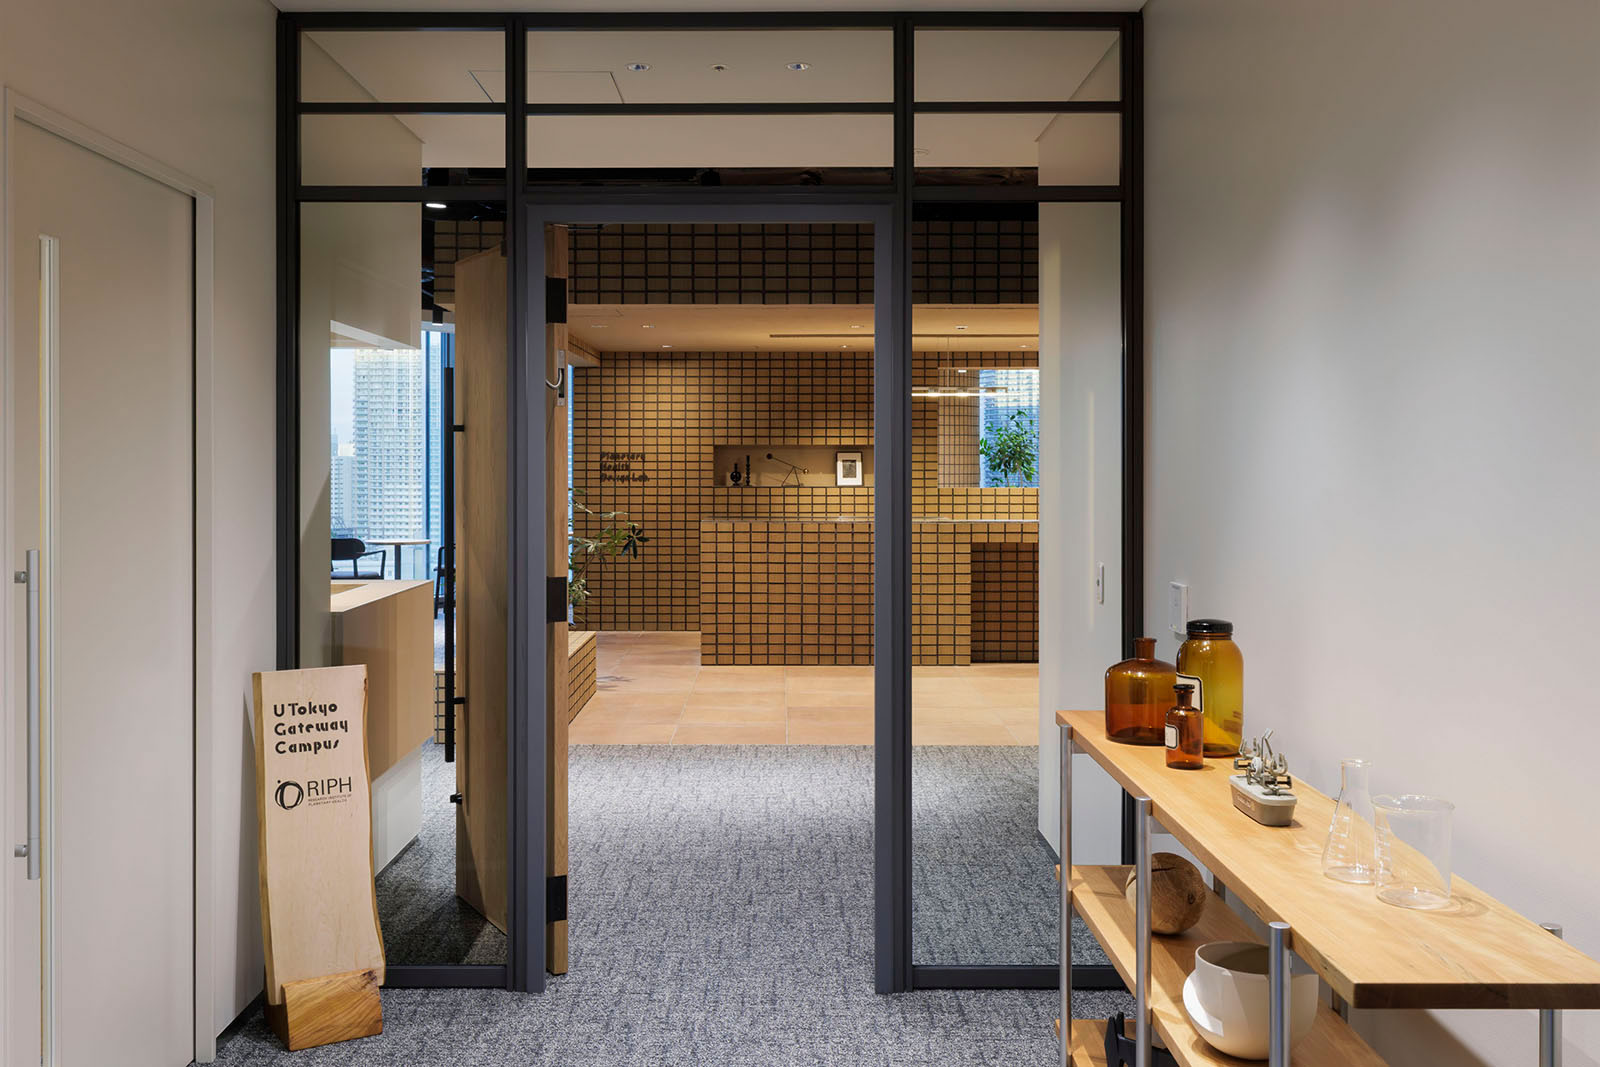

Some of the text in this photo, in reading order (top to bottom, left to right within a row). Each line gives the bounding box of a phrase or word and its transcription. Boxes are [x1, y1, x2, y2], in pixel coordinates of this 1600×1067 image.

[273, 702, 338, 718] U Tokyo
[274, 720, 348, 736] Gateway
[275, 739, 340, 755] Campus
[307, 776, 352, 797] RIPH
